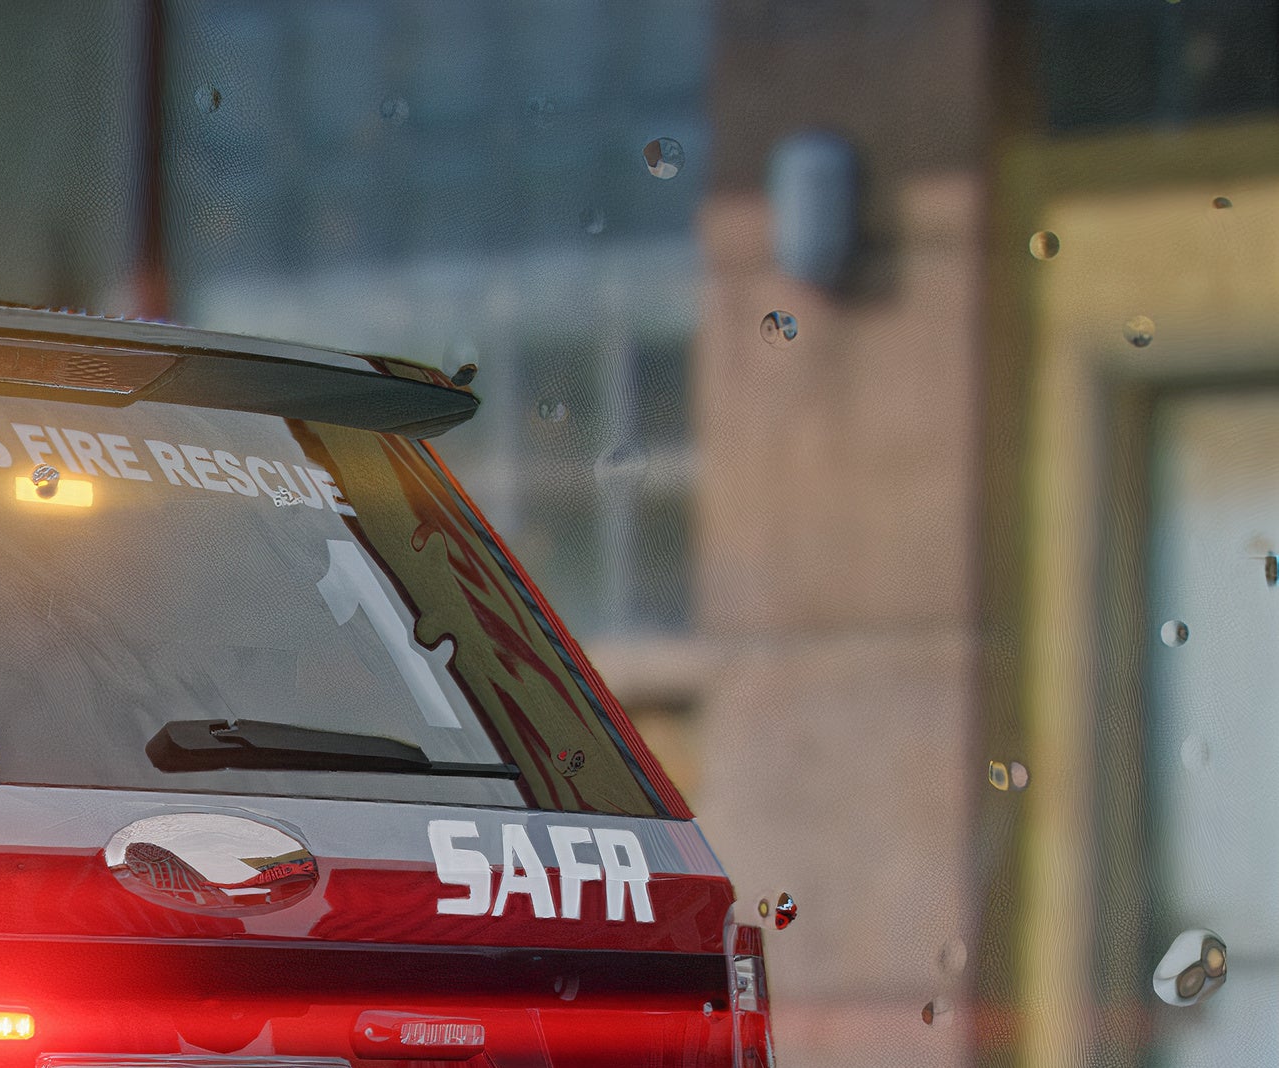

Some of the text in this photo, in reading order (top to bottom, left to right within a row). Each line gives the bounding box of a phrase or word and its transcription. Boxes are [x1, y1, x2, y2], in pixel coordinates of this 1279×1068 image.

[10, 422, 153, 482] FIRE
[143, 439, 357, 516] RESCUE
[316, 539, 463, 729] 1
[428, 820, 655, 923] SAFR
